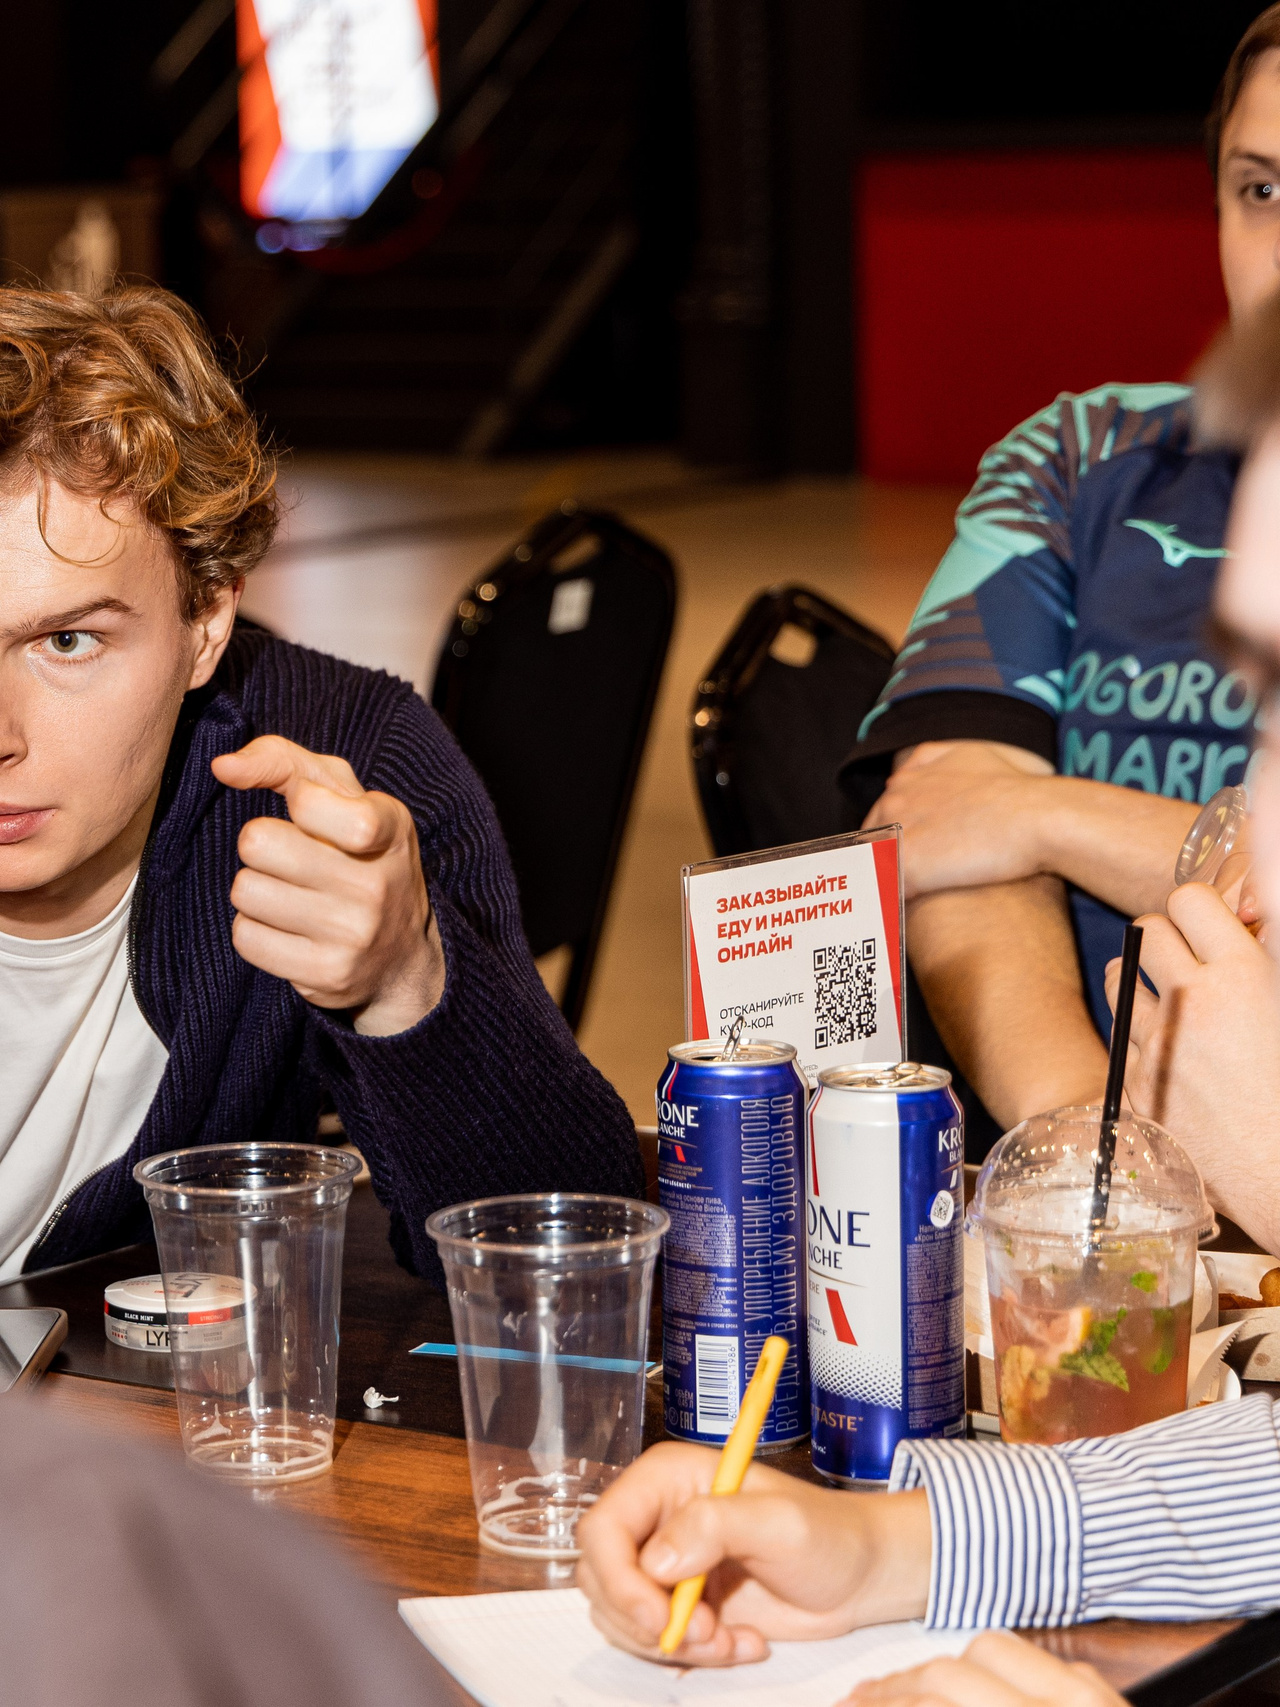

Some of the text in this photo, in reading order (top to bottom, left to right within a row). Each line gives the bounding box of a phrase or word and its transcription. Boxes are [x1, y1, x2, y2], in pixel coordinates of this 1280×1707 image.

[1064, 651, 1265, 730] OGORO
[716, 874, 848, 914] ЗАКАЗЫВАЙТЕ
[717, 898, 853, 940] ЕДУ И НАПИТКИ
[717, 933, 793, 963] ОНЛАЙН
[719, 992, 805, 1020] ОТСКАНИРУЙТЕ
[657, 1097, 700, 1128] RONE
[740, 1098, 771, 1186] АЛКОГОЛЯ
[770, 1094, 798, 1224] ЗДОРОВЬЮ
[807, 1199, 871, 1248] ONE
[741, 1194, 773, 1323] УПОТРЕБЛЕНИЕ
[808, 1242, 843, 1270] NCHE
[772, 1233, 798, 1334] ВАШЕМУ
[124, 1312, 154, 1322] BLACK MINT
[727, 1346, 737, 1382] 041986
[728, 1385, 737, 1419] 600682
